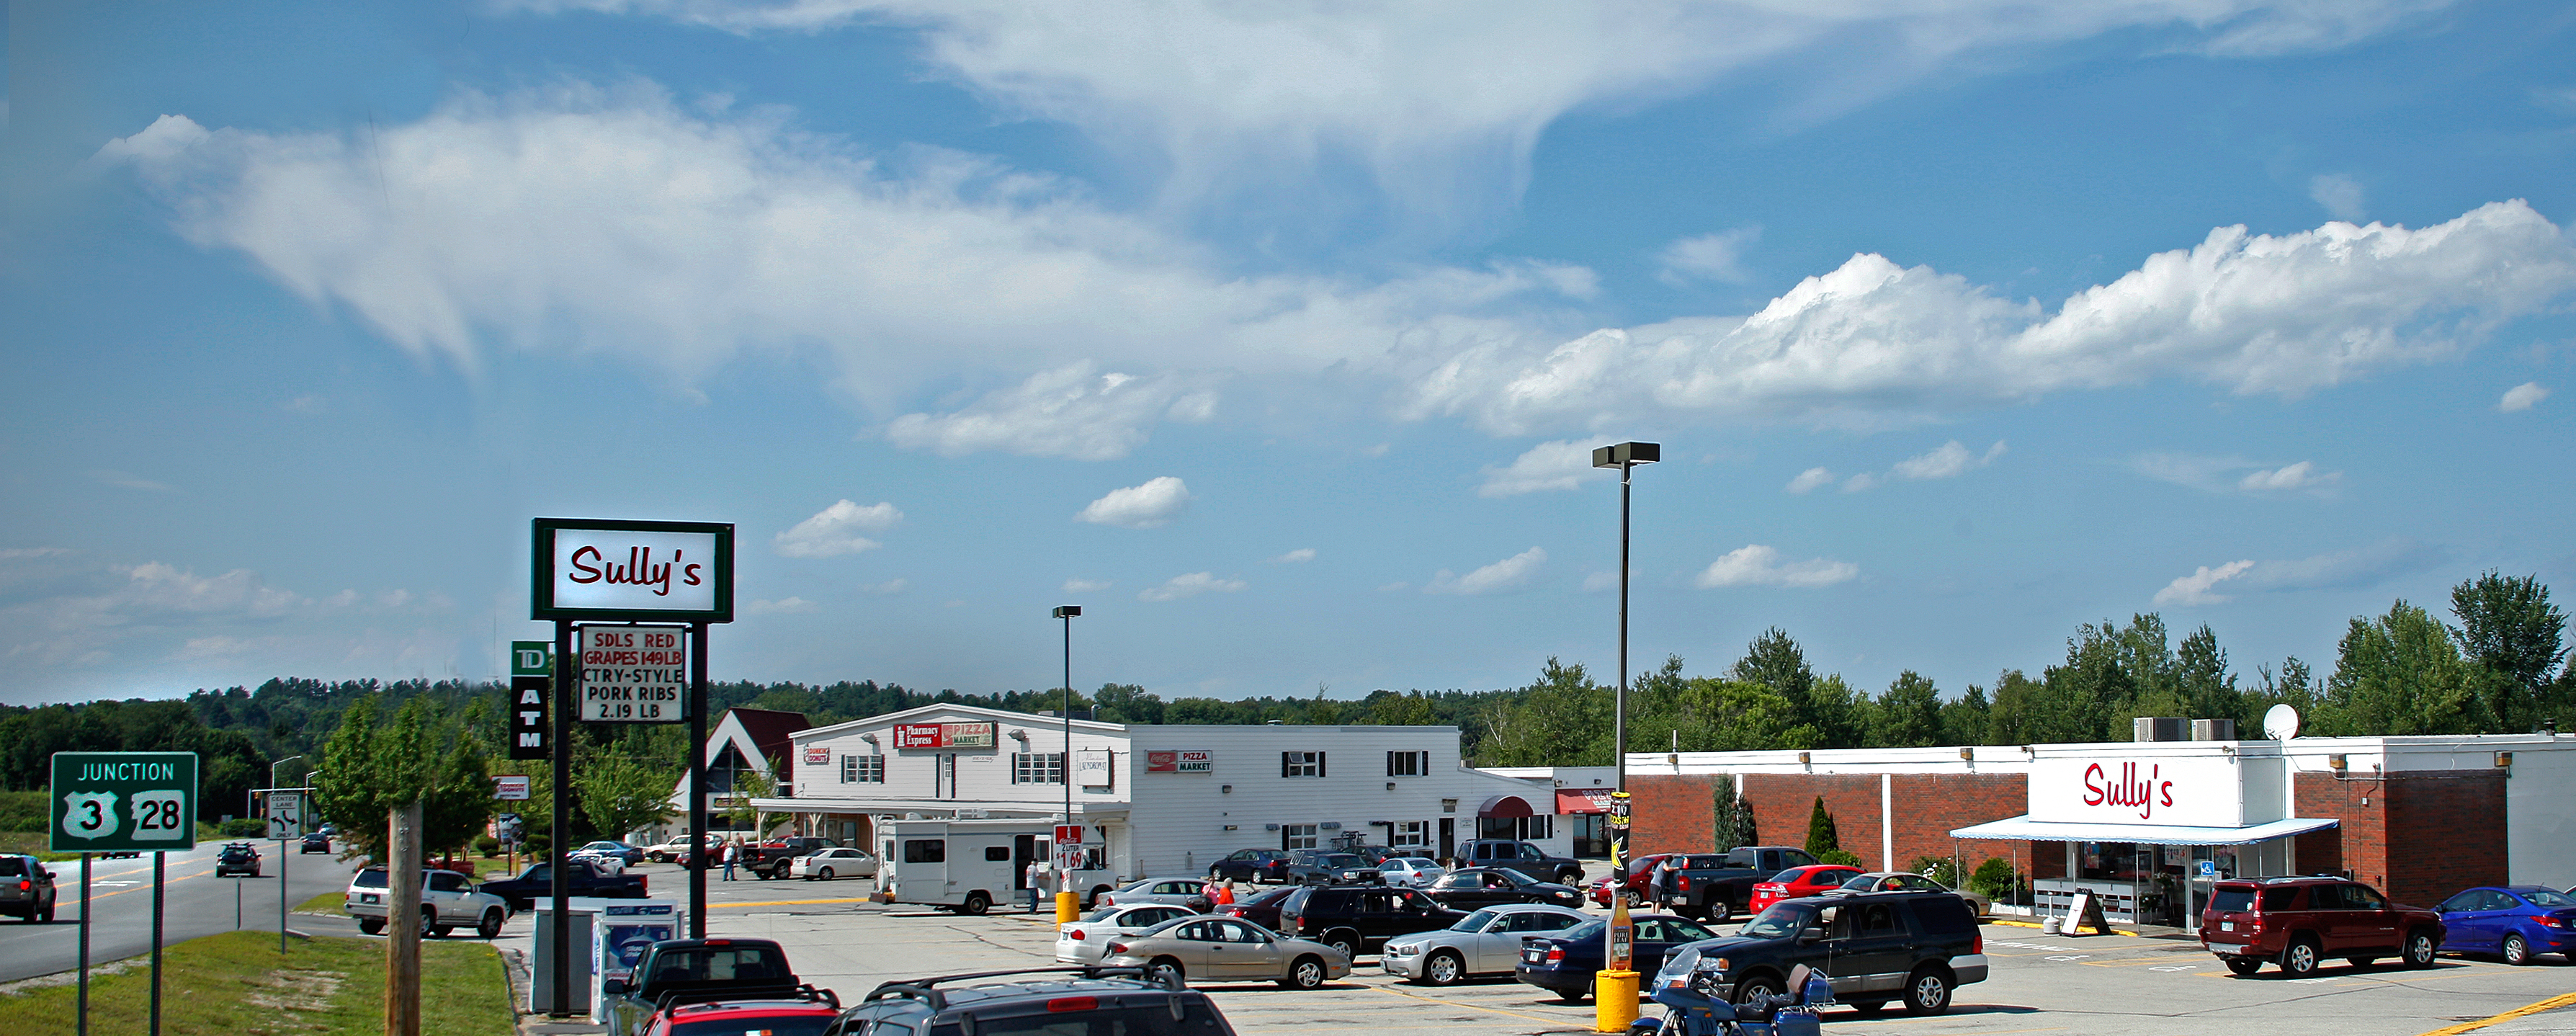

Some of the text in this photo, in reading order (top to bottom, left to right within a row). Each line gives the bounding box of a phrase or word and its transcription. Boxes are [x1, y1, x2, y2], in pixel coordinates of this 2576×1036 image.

[569, 545, 701, 596] Sully's
[595, 633, 675, 648] SDLS RED
[516, 650, 545, 668] TD
[584, 651, 638, 665] GRAPES
[583, 668, 683, 683] CTRY-STYLE
[589, 686, 676, 700] PORK RIBS
[519, 689, 541, 747] ATM
[600, 704, 660, 718] 2.19 LB
[906, 725, 939, 737] Pharmacy
[954, 724, 991, 736] PIZZA
[906, 736, 932, 747] Express
[78, 763, 174, 781] JUNCTION
[1179, 762, 1211, 771] MARKET
[1581, 790, 1613, 800] PIZZ
[2083, 762, 2173, 820] Sully's
[80, 800, 103, 830] 3
[140, 800, 180, 830] 28
[1062, 843, 1066, 852] 2
